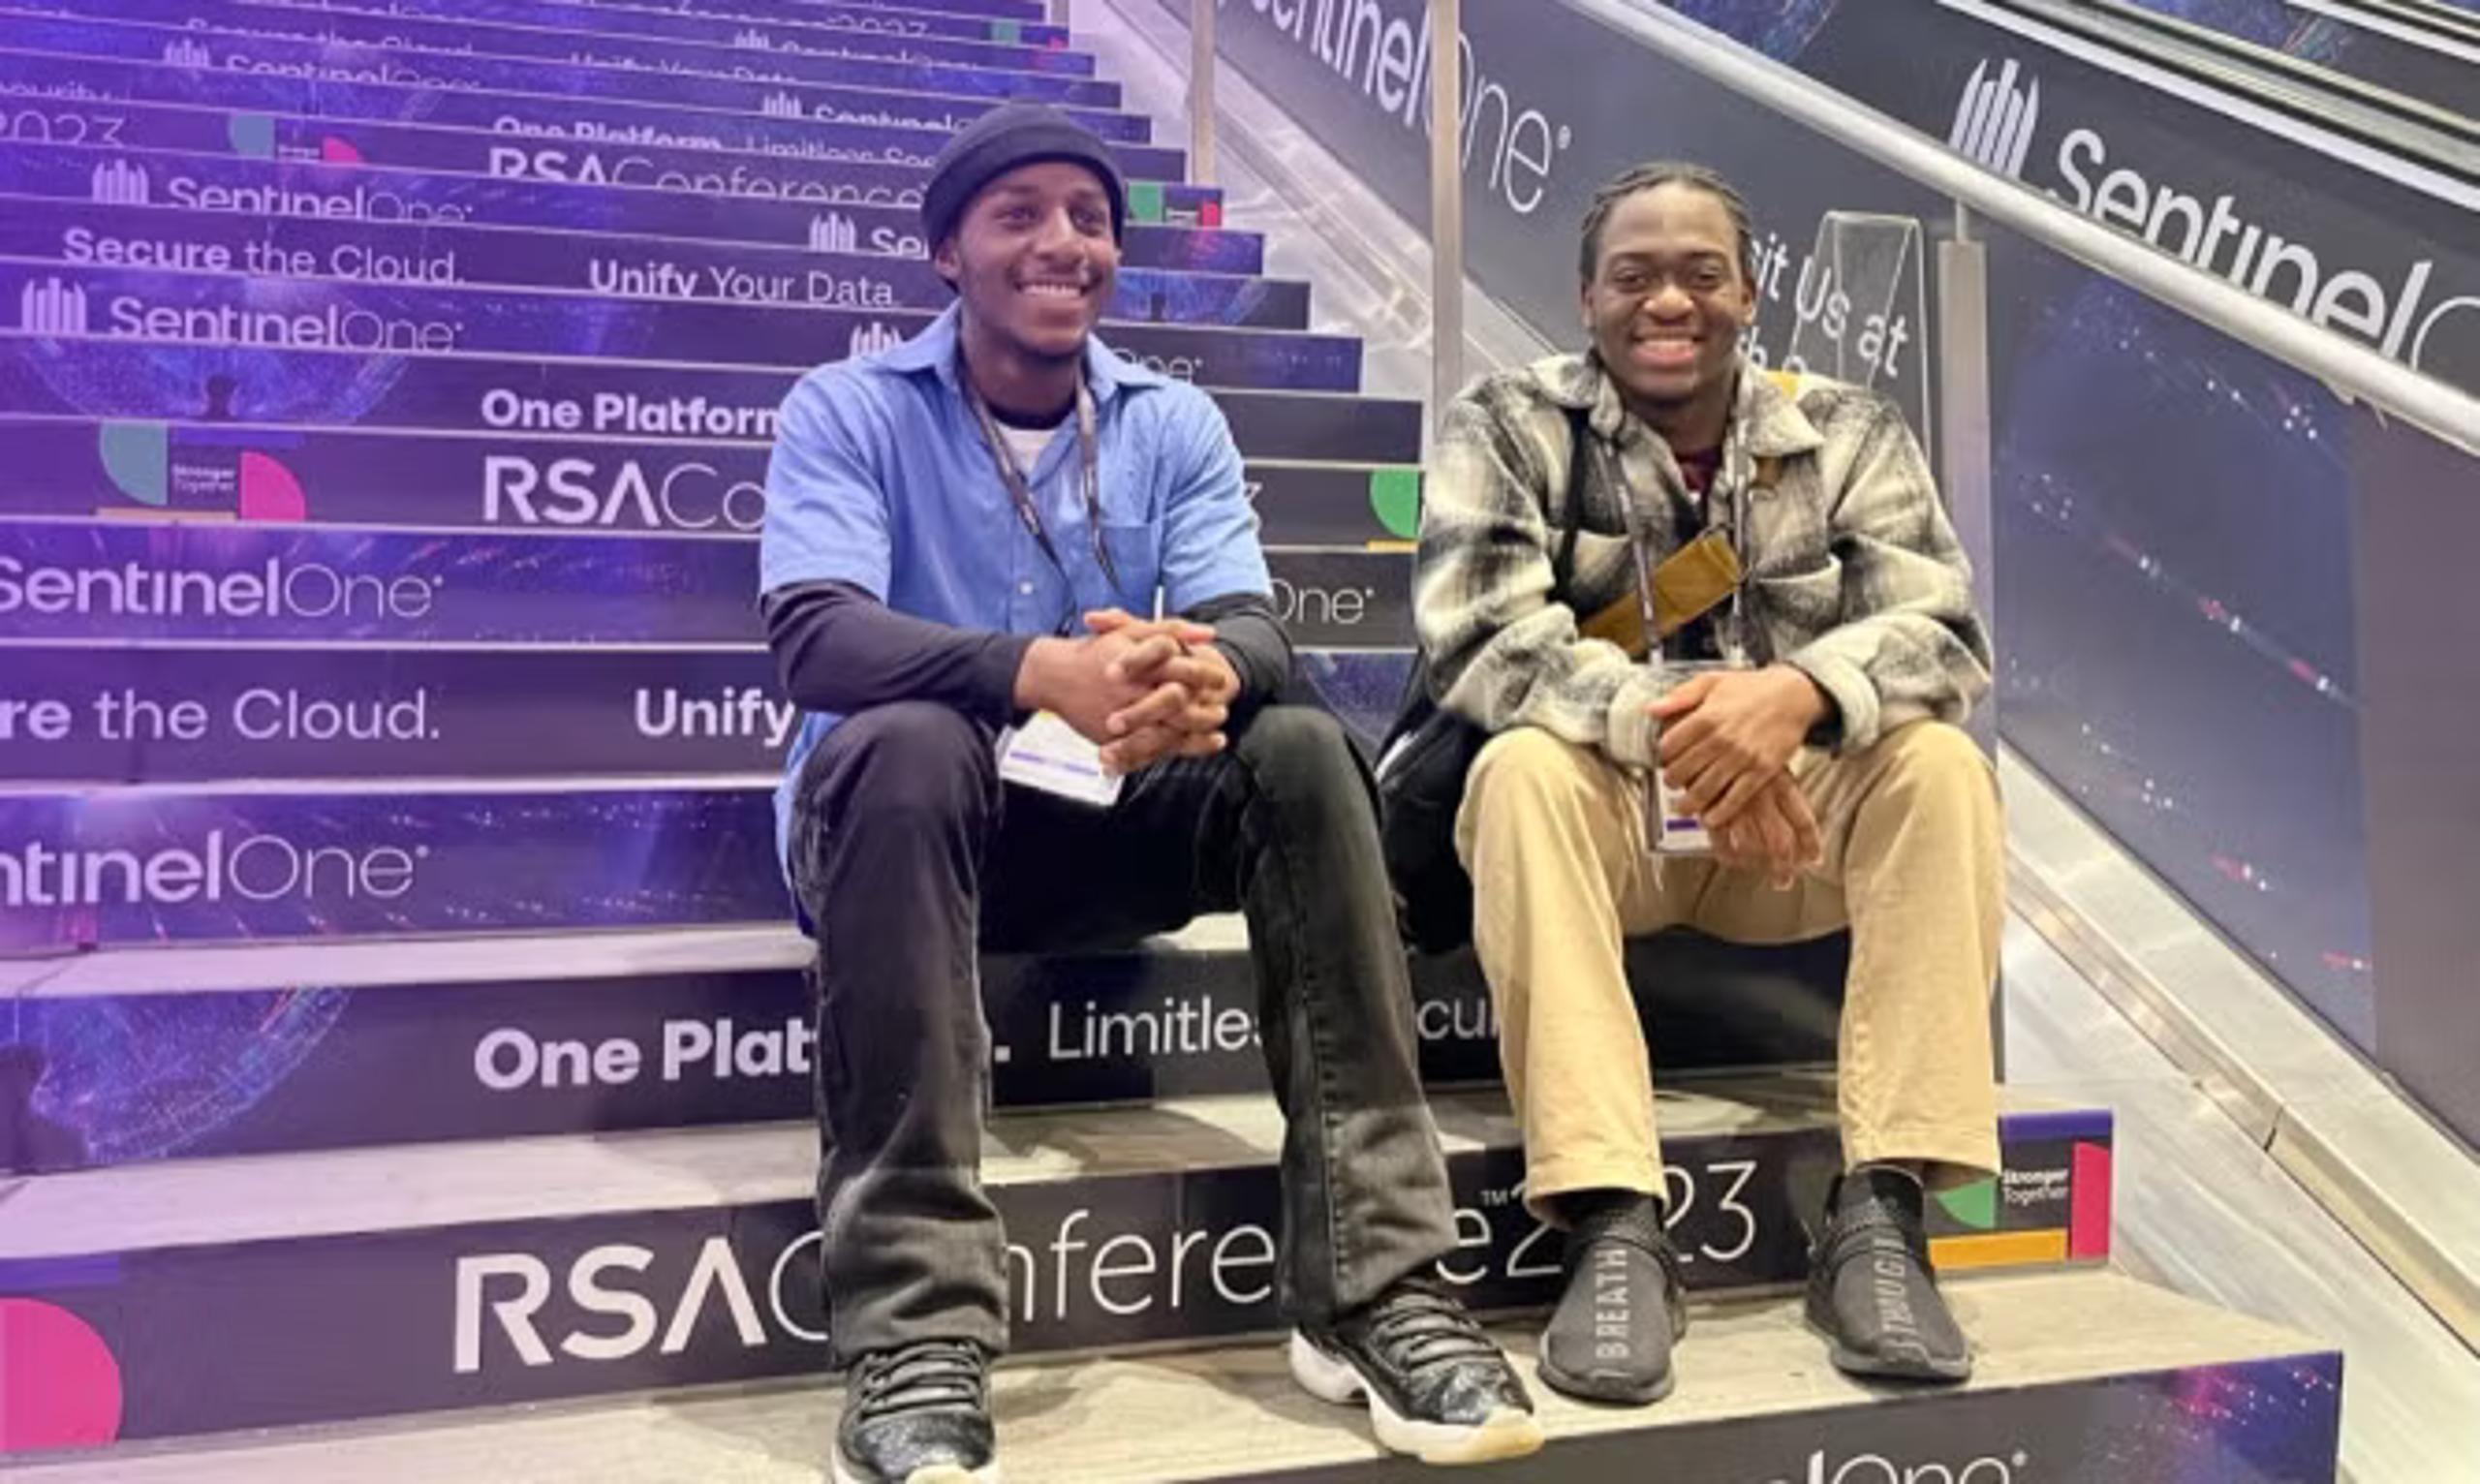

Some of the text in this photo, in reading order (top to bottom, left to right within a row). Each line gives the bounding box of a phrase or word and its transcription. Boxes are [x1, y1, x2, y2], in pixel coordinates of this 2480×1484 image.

[63, 228, 465, 285] Secure the Cloud.
[589, 258, 698, 297] Unify
[707, 264, 795, 299] Your
[109, 295, 455, 353] SentinelOne
[1795, 256, 1851, 339] Us
[1857, 312, 1908, 379] at
[481, 388, 582, 428] One
[94, 688, 208, 740] the
[232, 688, 440, 740] Cloud.
[636, 686, 796, 747] Unify
[474, 1028, 642, 1090] One
[1595, 1249, 1630, 1359] BREATH
